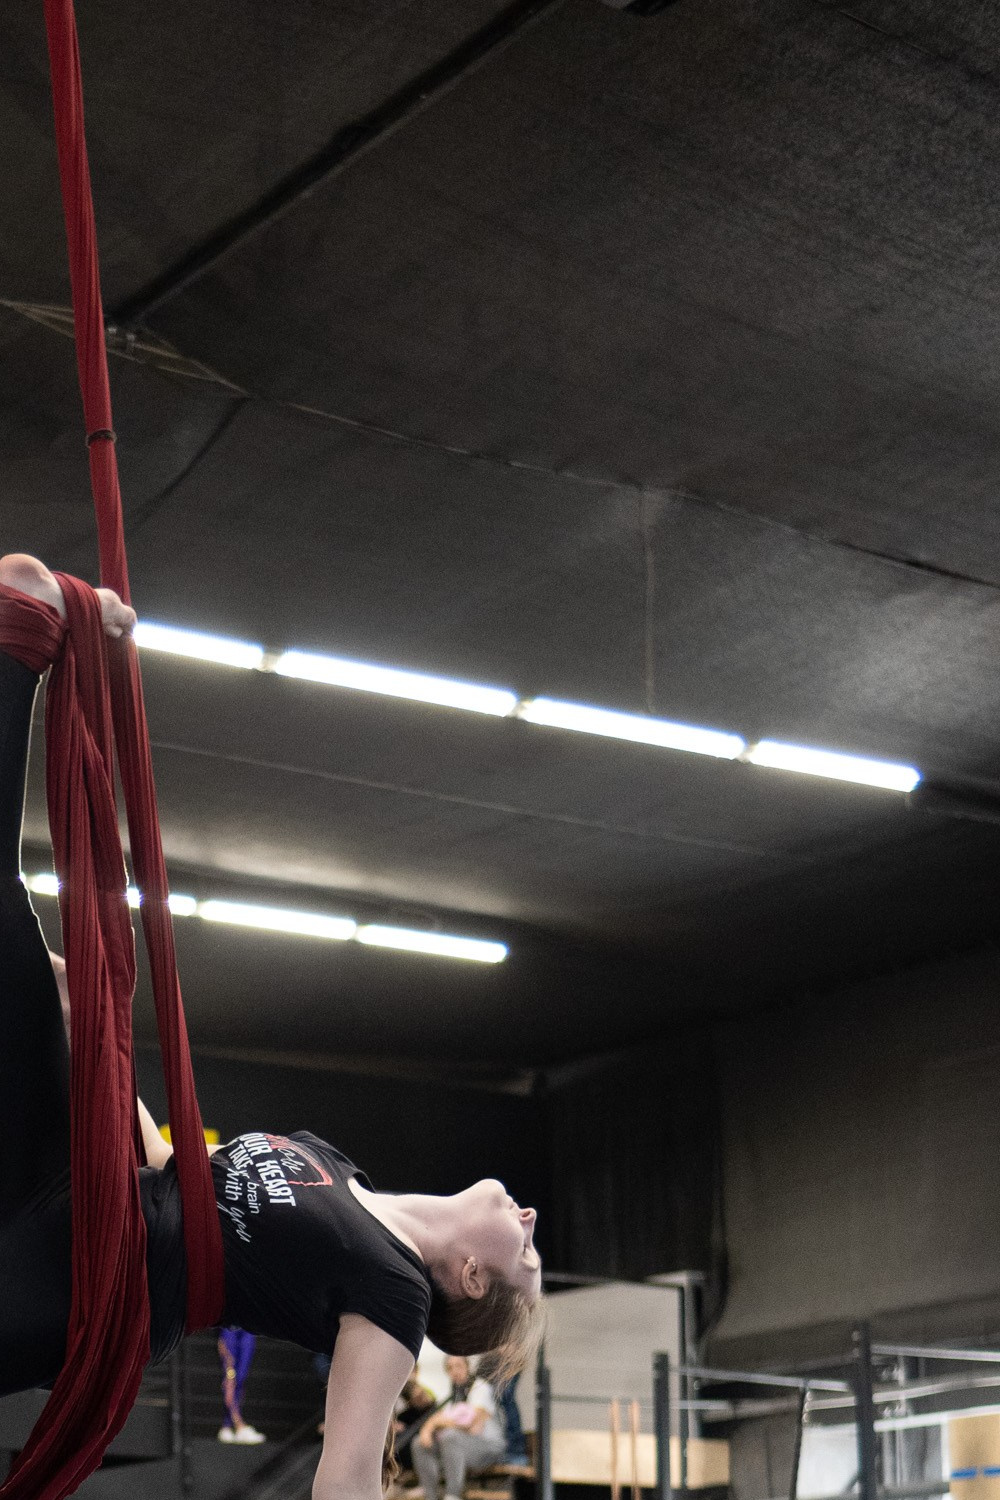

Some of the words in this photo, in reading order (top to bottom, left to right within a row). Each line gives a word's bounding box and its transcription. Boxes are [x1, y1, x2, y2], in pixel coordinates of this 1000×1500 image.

[239, 1132, 273, 1158] OUR
[228, 1143, 254, 1170] TAKE
[246, 1181, 261, 1214] brain
[255, 1160, 297, 1207] HEART
